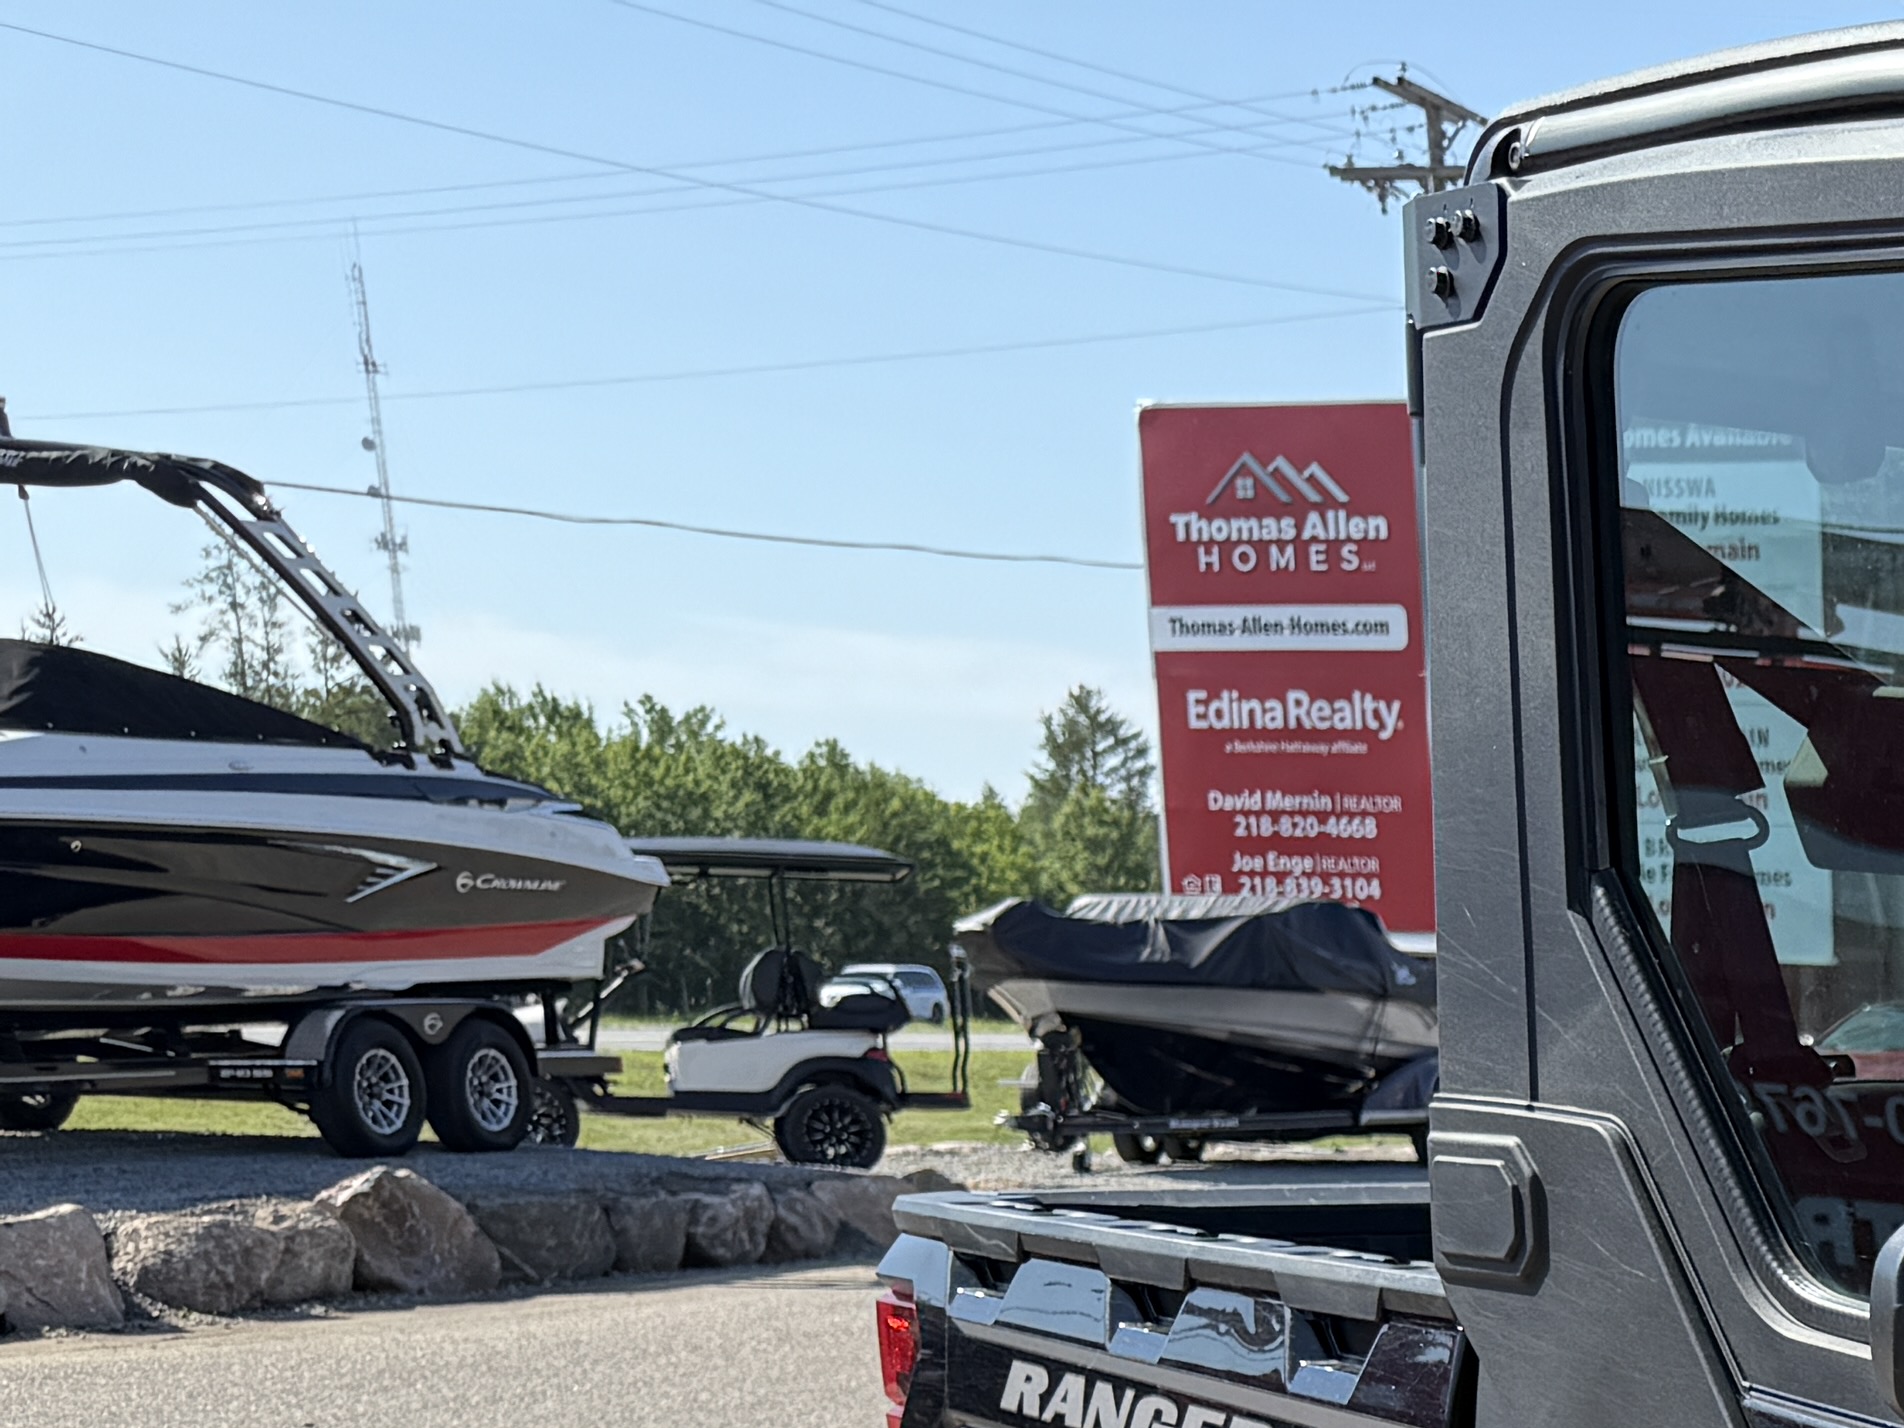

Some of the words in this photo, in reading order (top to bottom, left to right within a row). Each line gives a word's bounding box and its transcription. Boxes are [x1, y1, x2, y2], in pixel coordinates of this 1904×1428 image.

[1623, 428, 1681, 449] omes
[1169, 511, 1297, 542] Thomas
[1302, 509, 1389, 541] Allen
[1197, 543, 1361, 573] HOMES
[1169, 615, 1390, 637] Thomas-Allen-Homes.com
[1207, 788, 1262, 811] David
[1265, 789, 1333, 812] Mernin
[1343, 795, 1402, 812] REALTOR
[1233, 814, 1378, 839] 218-820-4668
[1231, 851, 1264, 872] Joe
[1266, 851, 1314, 876] Enge
[1237, 875, 1382, 900] 218-839-3104
